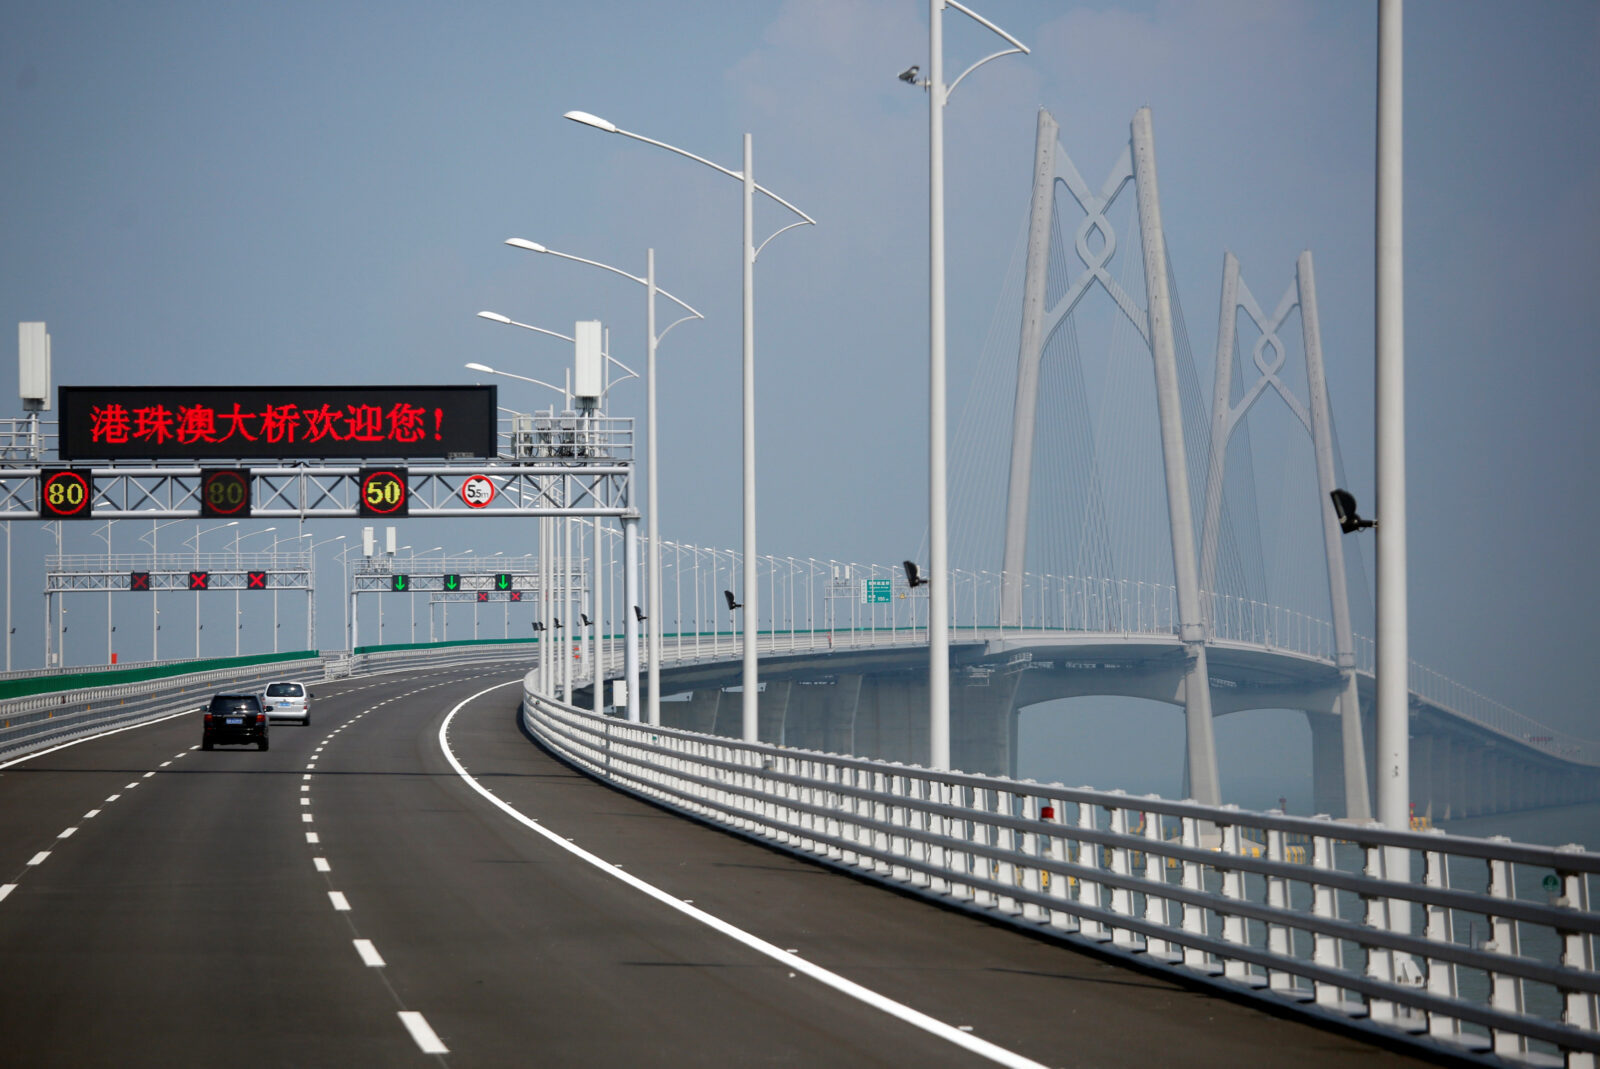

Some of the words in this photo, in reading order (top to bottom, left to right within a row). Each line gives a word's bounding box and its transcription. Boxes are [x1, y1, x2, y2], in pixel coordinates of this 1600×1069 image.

[49, 483, 83, 505] 80
[209, 482, 243, 504] 80
[367, 480, 401, 504] 50
